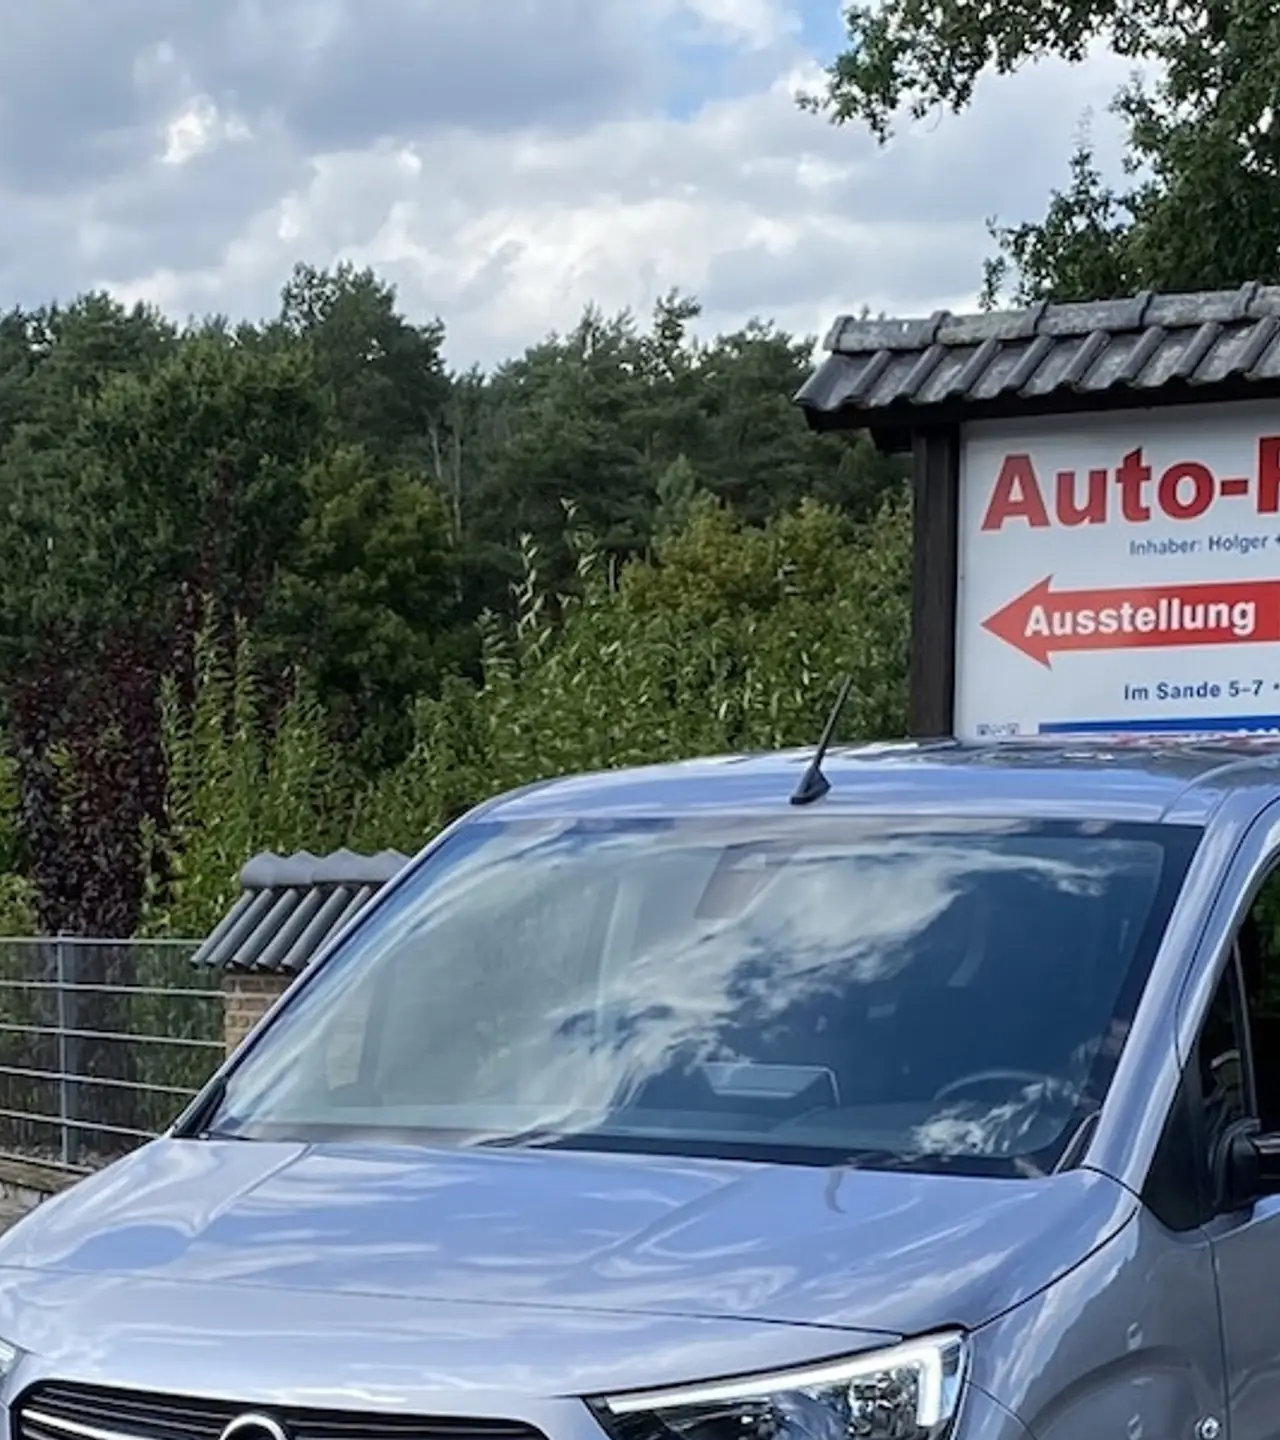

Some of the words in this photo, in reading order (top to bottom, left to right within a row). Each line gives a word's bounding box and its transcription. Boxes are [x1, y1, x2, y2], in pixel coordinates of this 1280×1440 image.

[1129, 535, 1203, 556] Inhaber:
[1207, 533, 1269, 555] Holger
[1022, 596, 1259, 638] Ausstellung
[1123, 684, 1149, 702] Im
[1155, 681, 1221, 701] Sande
[1228, 679, 1264, 699] 5-7
